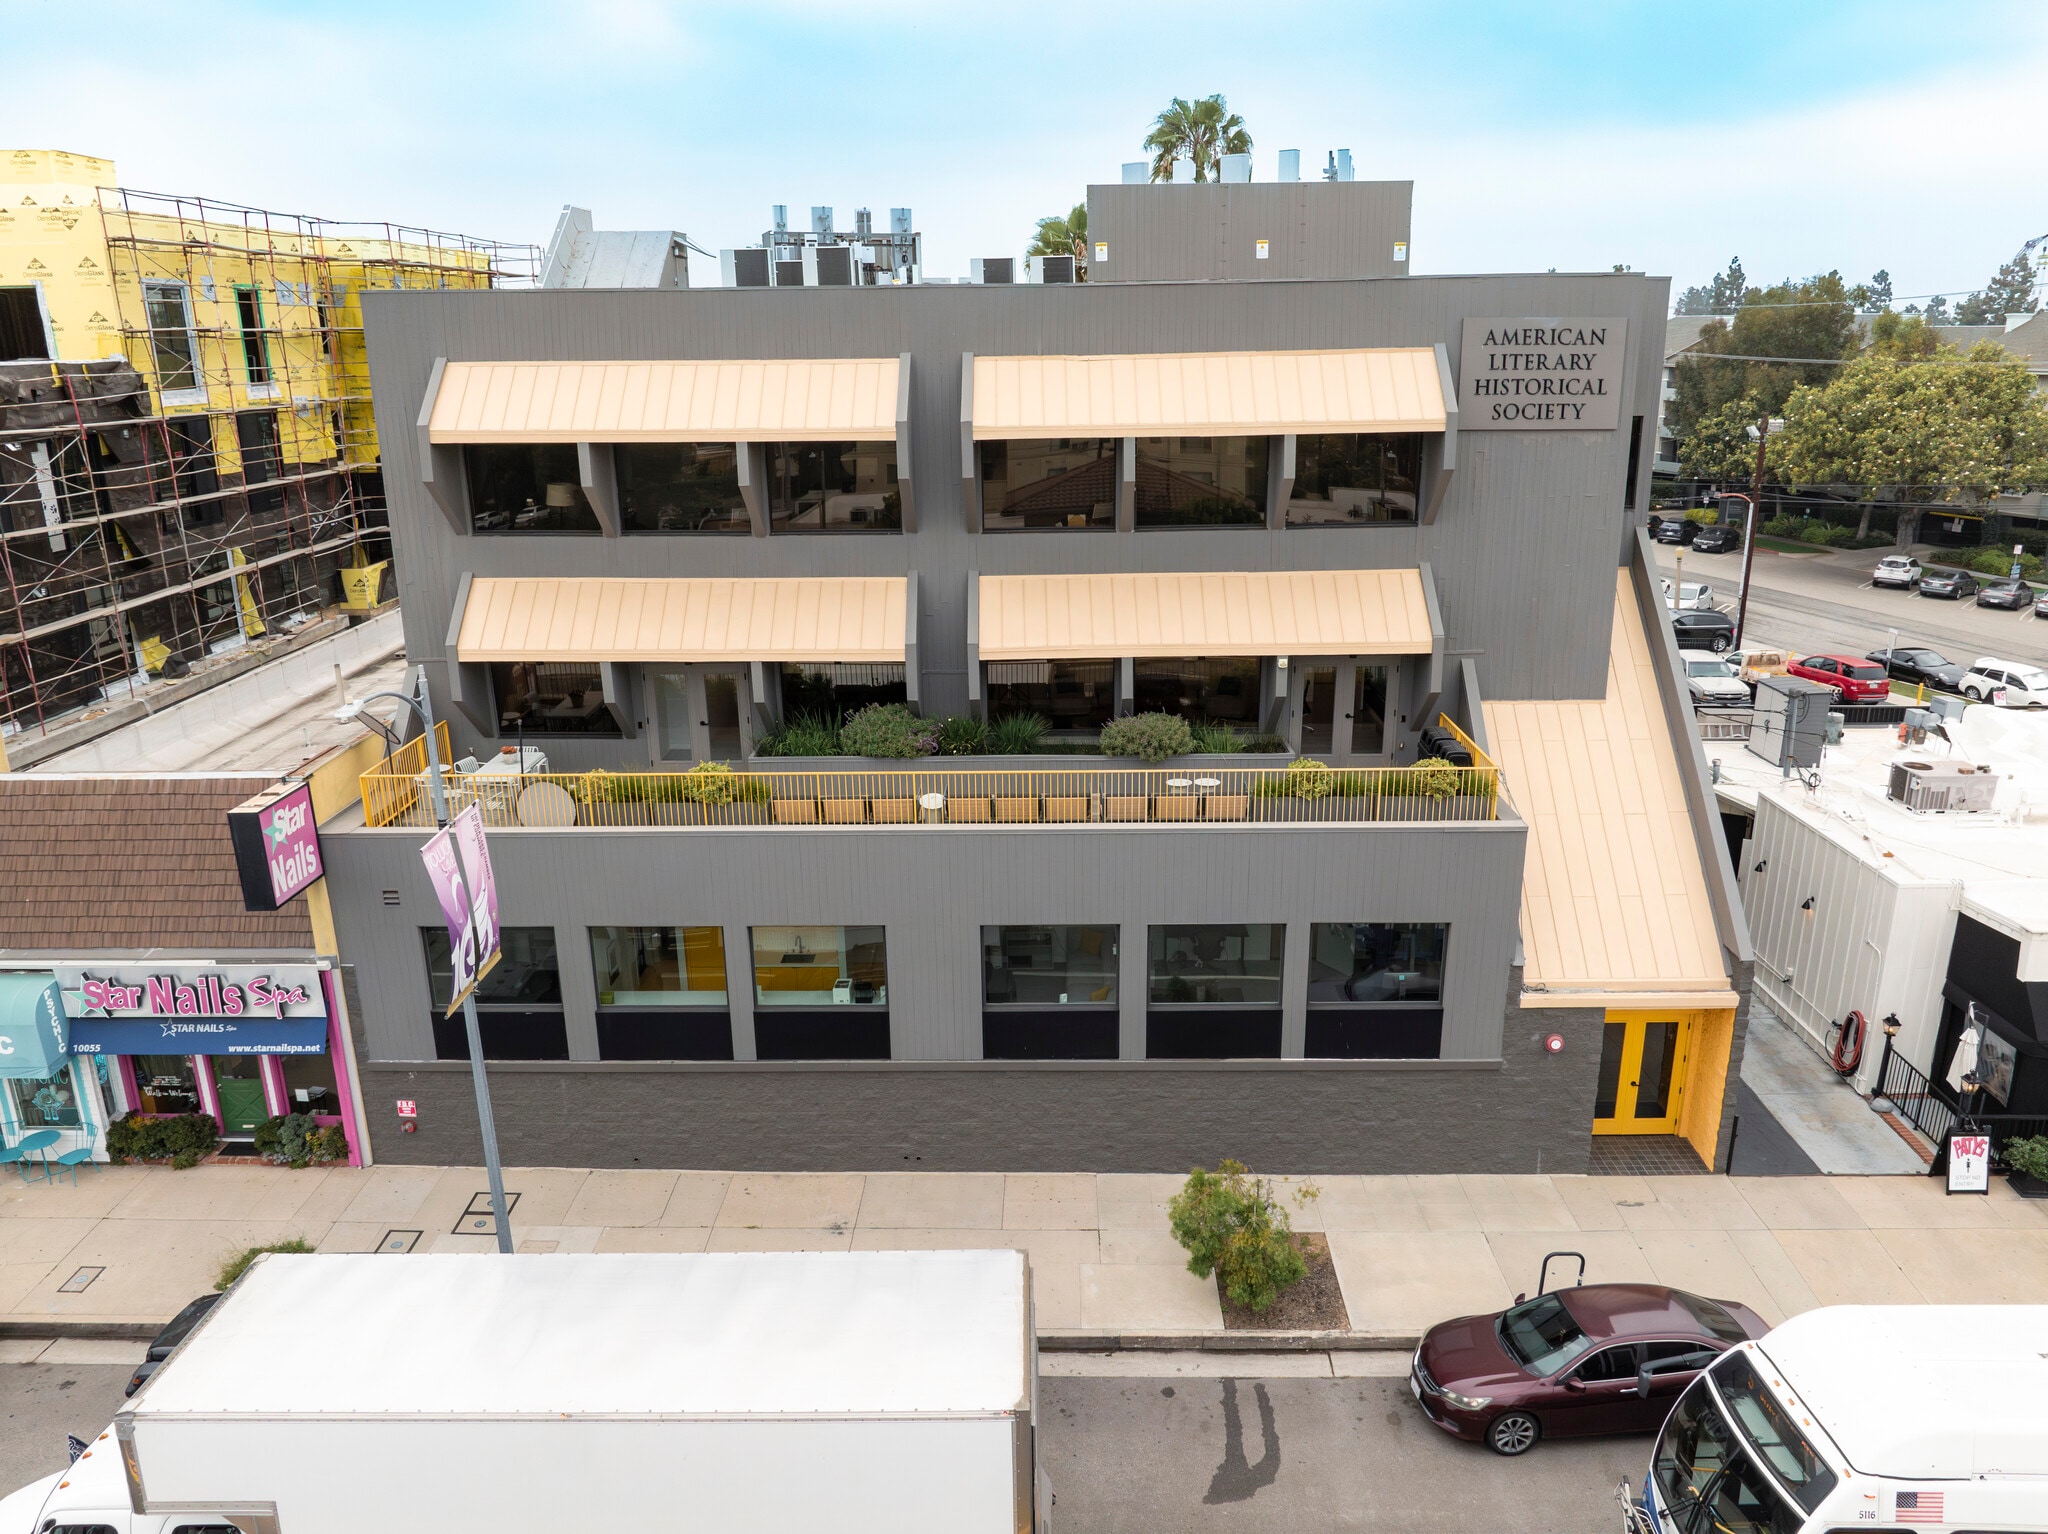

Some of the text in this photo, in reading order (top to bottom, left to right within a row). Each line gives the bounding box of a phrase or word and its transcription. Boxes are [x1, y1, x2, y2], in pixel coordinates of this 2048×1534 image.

[1482, 327, 1608, 346] AMERICAN
[1489, 353, 1597, 371] LITERARY
[1474, 378, 1608, 396] HISTORICAL
[1491, 403, 1586, 421] SOCIETY
[274, 801, 307, 841] Star
[271, 840, 317, 898] Nails
[83, 977, 310, 1019] Star Nails Spa
[43, 989, 66, 1053] PSYCHIC
[171, 1023, 195, 1033] STAR
[196, 1023, 224, 1033] NAILS
[73, 1044, 101, 1053] 10055
[228, 1043, 321, 1054] www.starnailspa.net
[1953, 1136, 1988, 1159] PATYS
[1859, 1510, 1876, 1519] 5116
